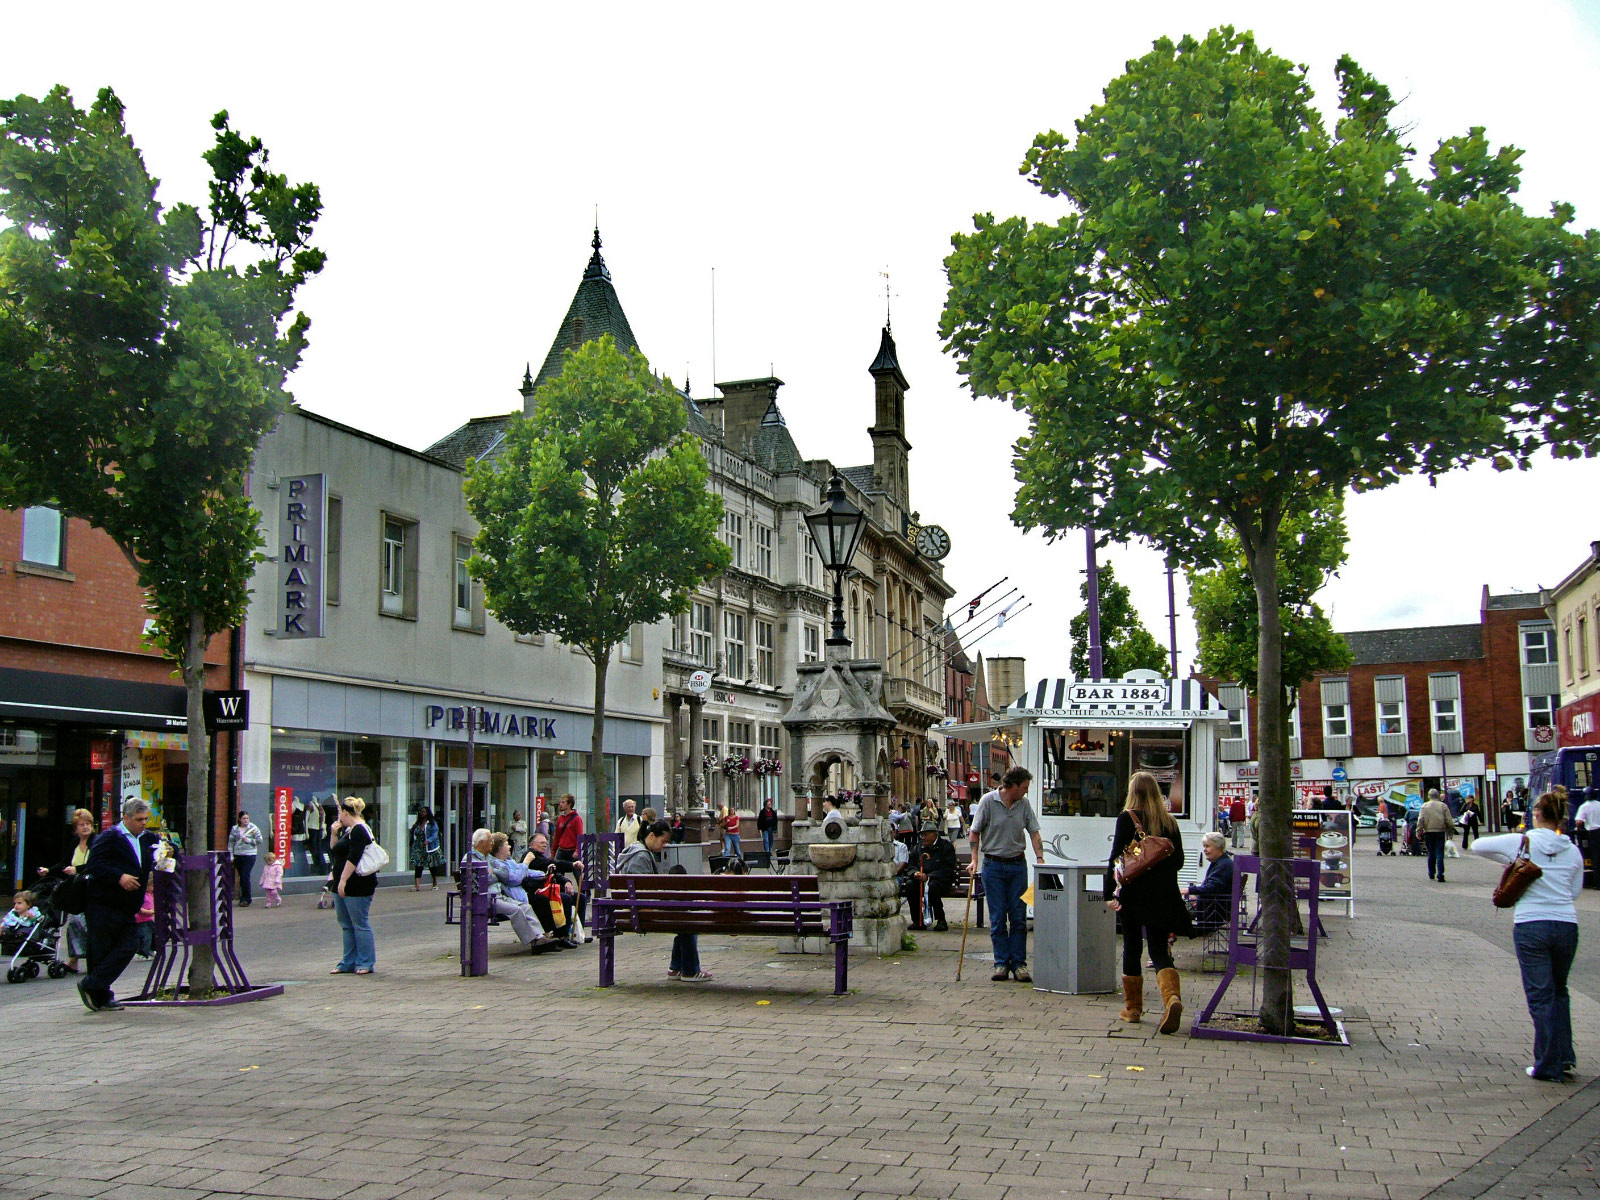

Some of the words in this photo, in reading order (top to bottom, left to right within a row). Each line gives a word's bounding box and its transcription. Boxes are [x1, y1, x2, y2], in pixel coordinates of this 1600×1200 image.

[284, 480, 309, 633] PRIMARK
[713, 691, 727, 703] HSBC
[1076, 688, 1114, 699] BAR
[1121, 688, 1160, 700] 1884
[218, 697, 242, 717] W
[1025, 708, 1095, 717] SMOOTHIE
[1100, 709, 1127, 717] BAR
[1135, 709, 1176, 717] SHAKE
[1572, 711, 1594, 738] COSTA
[281, 764, 315, 772] PRIMARK
[1358, 784, 1386, 796] LAST!
[279, 789, 289, 866] reductions
[1043, 892, 1059, 901] Litter
